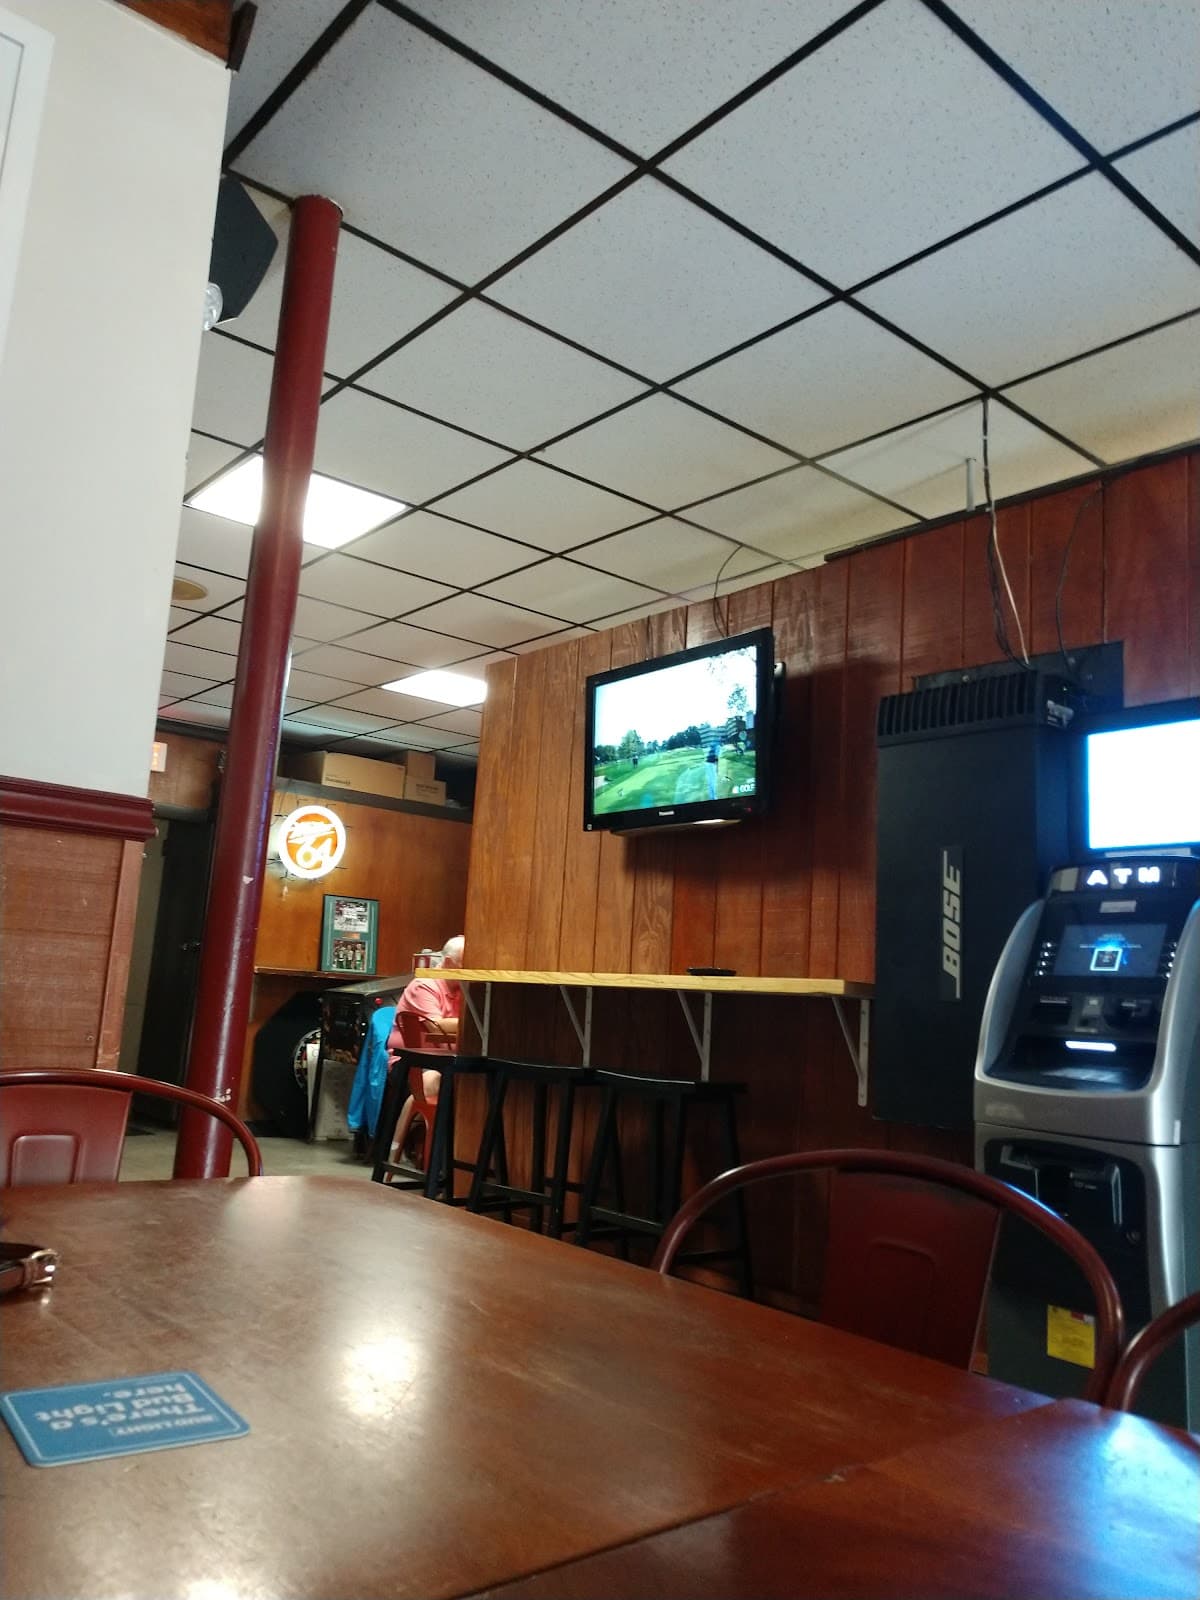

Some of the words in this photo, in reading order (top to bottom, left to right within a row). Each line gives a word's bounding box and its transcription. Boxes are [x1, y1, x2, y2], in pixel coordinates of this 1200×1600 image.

[1086, 866, 1161, 886] ATM
[942, 850, 961, 999] BOSE
[103, 1383, 186, 1398] here.
[131, 1393, 195, 1408] Bud
[35, 1402, 125, 1421] Light
[80, 1403, 204, 1426] There's
[50, 1419, 74, 1432] a
